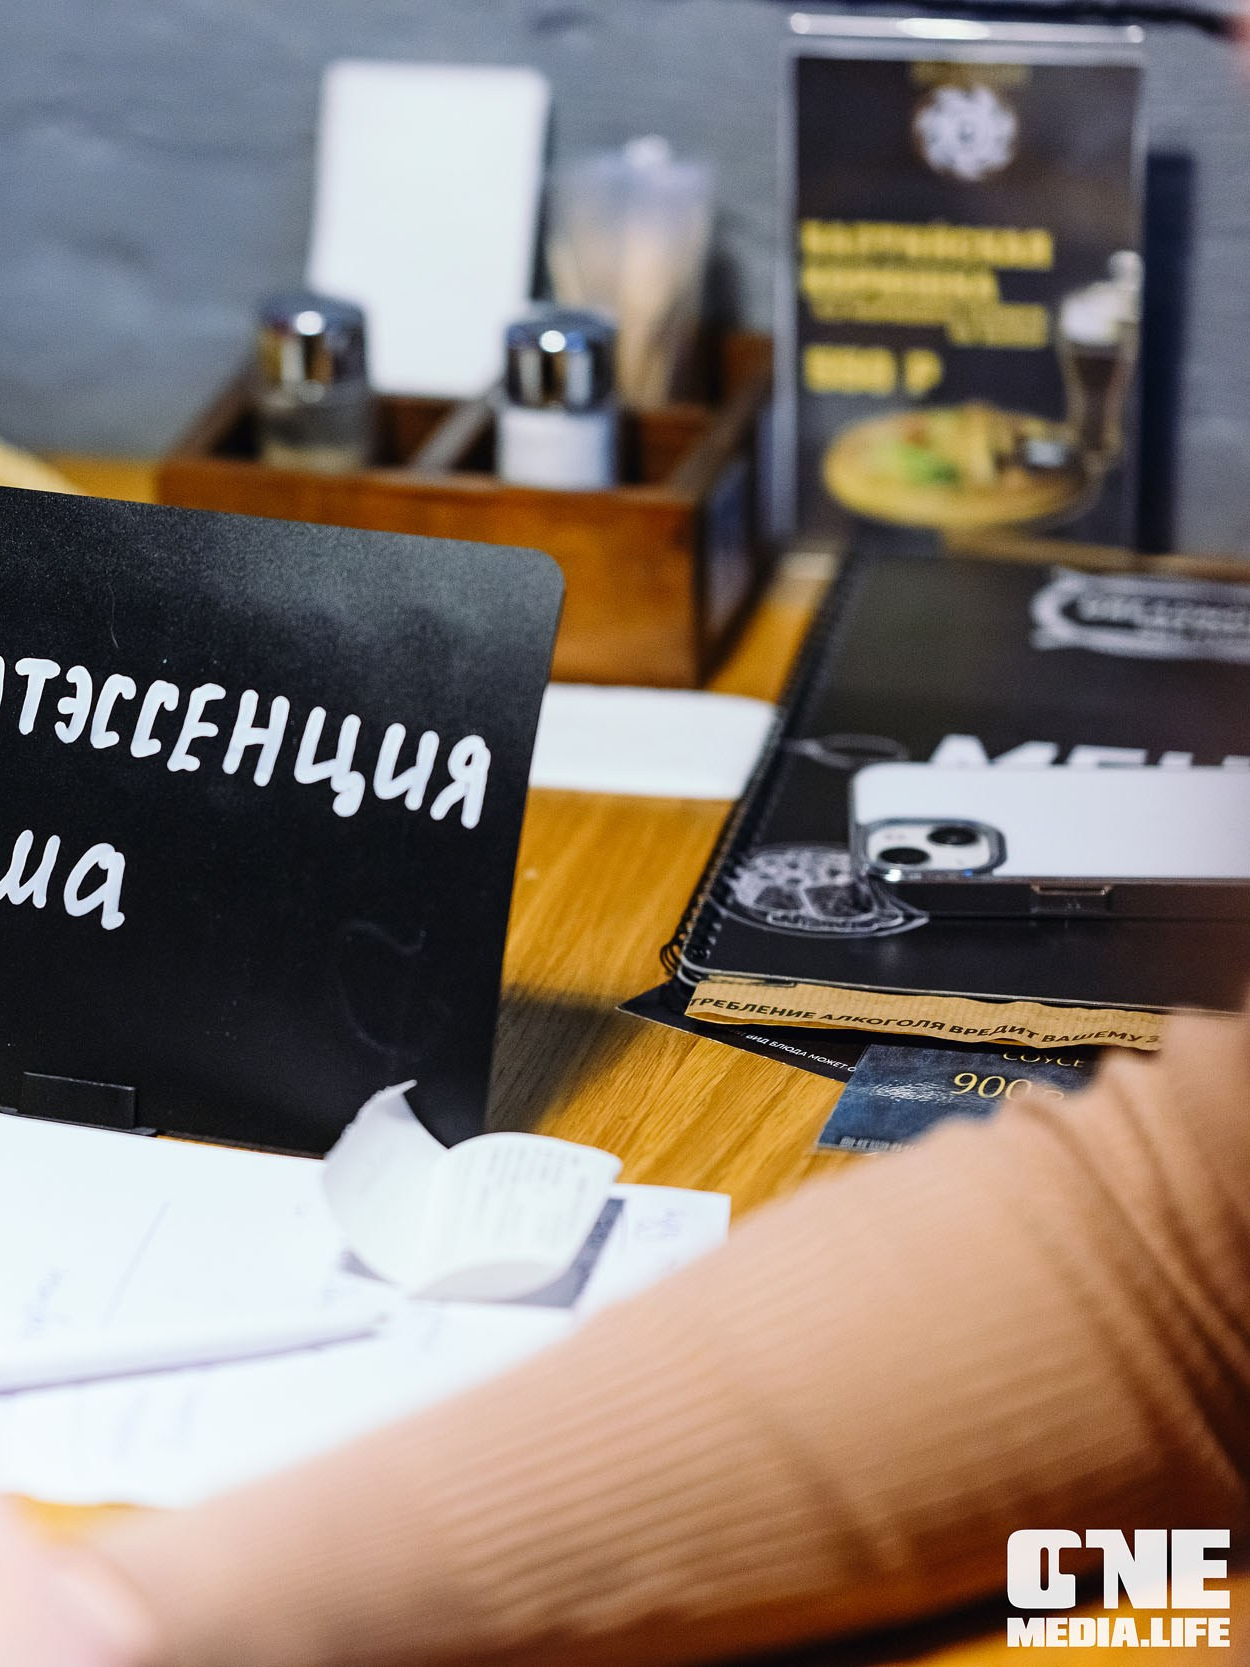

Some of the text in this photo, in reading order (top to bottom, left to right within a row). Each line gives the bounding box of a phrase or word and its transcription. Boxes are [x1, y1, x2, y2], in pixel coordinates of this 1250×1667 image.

[689, 997, 817, 1020] ТРЕБЛЕНИЕ
[820, 1013, 946, 1031] АЛКОГОЛЯ
[948, 1024, 1040, 1039] ВРЕДИТ
[1041, 1030, 1144, 1043] ВАШЕМУ
[769, 1041, 807, 1057] БЛЮДА
[807, 1053, 848, 1069] МОЖЕТ
[951, 1071, 1032, 1102] 900
